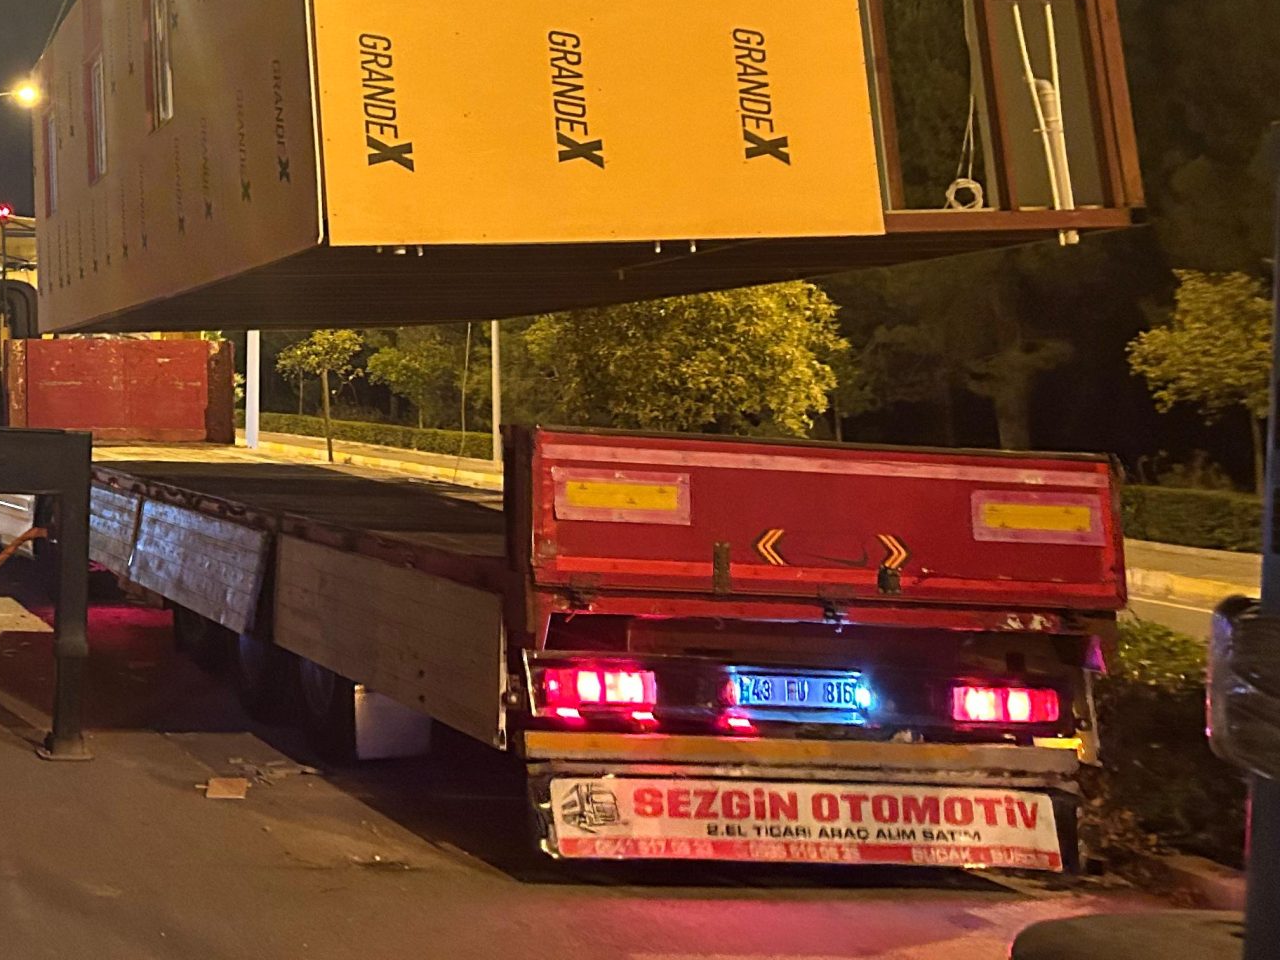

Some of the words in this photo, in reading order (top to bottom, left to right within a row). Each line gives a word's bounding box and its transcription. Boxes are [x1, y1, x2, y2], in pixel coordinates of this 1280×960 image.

[359, 33, 415, 173] GRANDEX
[548, 30, 605, 169] GRANDEX
[732, 28, 791, 166] GRANDEX
